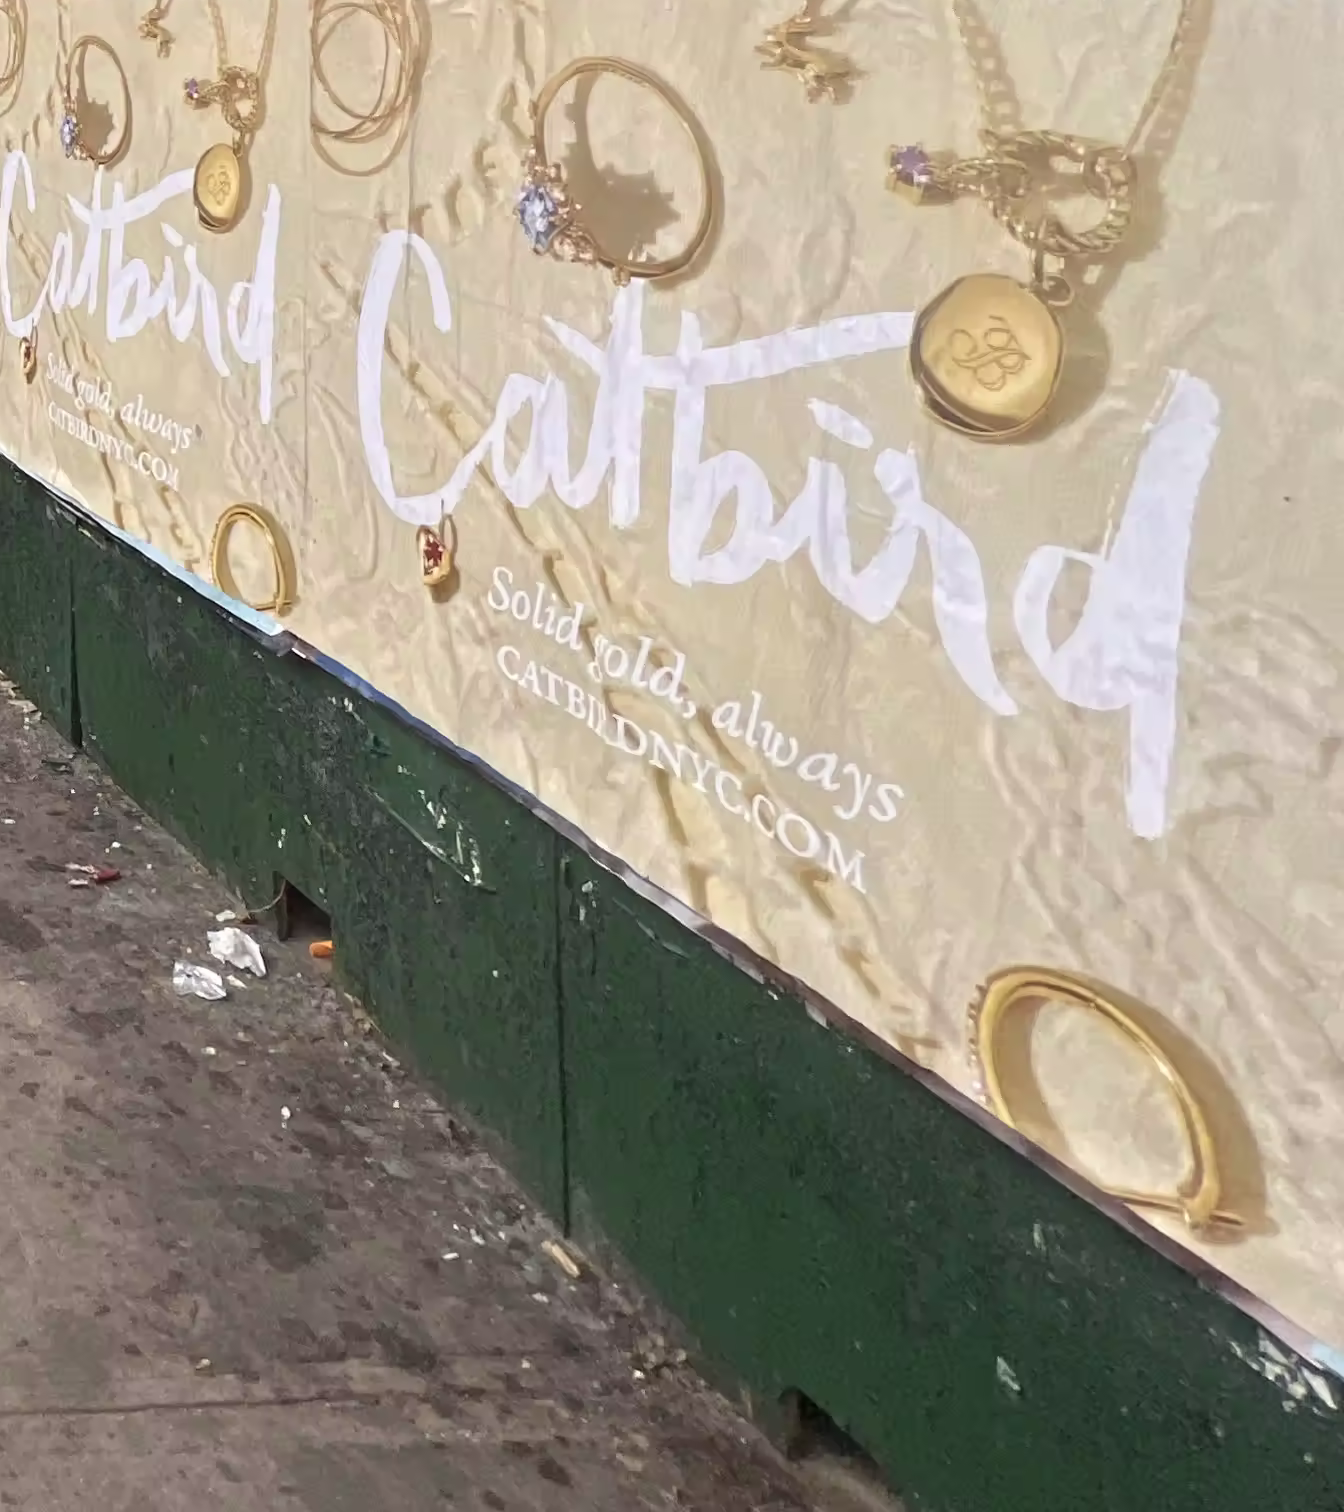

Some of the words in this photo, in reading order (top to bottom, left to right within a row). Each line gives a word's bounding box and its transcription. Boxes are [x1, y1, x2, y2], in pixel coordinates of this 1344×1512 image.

[0, 149, 281, 425] Catbird
[120, 393, 193, 456] always
[358, 229, 1220, 840] Catbird
[487, 566, 585, 651] Solid
[588, 635, 697, 719] gold,
[711, 691, 905, 821] always
